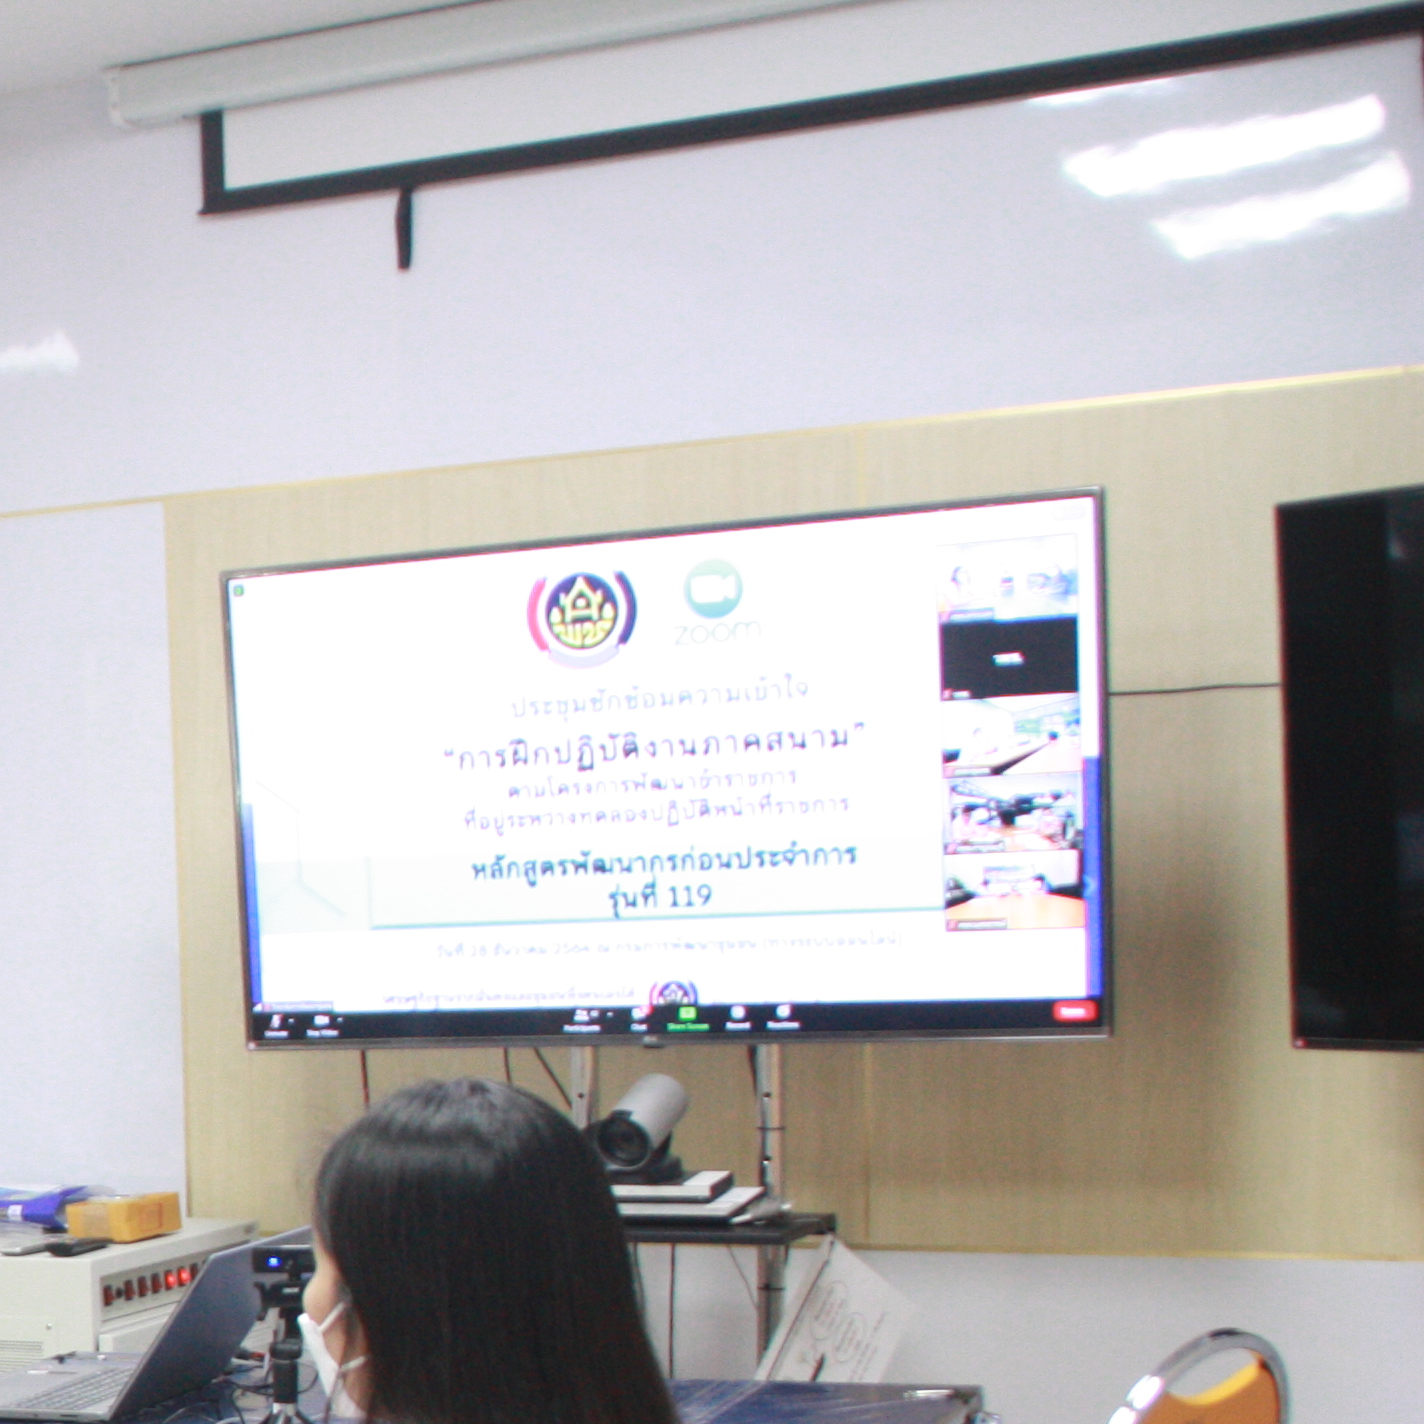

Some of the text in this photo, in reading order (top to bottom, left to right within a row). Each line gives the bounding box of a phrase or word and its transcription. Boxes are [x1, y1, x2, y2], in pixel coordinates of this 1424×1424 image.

[673, 620, 762, 646] zoom
[470, 840, 859, 888] หลักสูตรพัฒนากรก่อนประจำการ
[607, 880, 713, 919] รุ่นที่ 119
